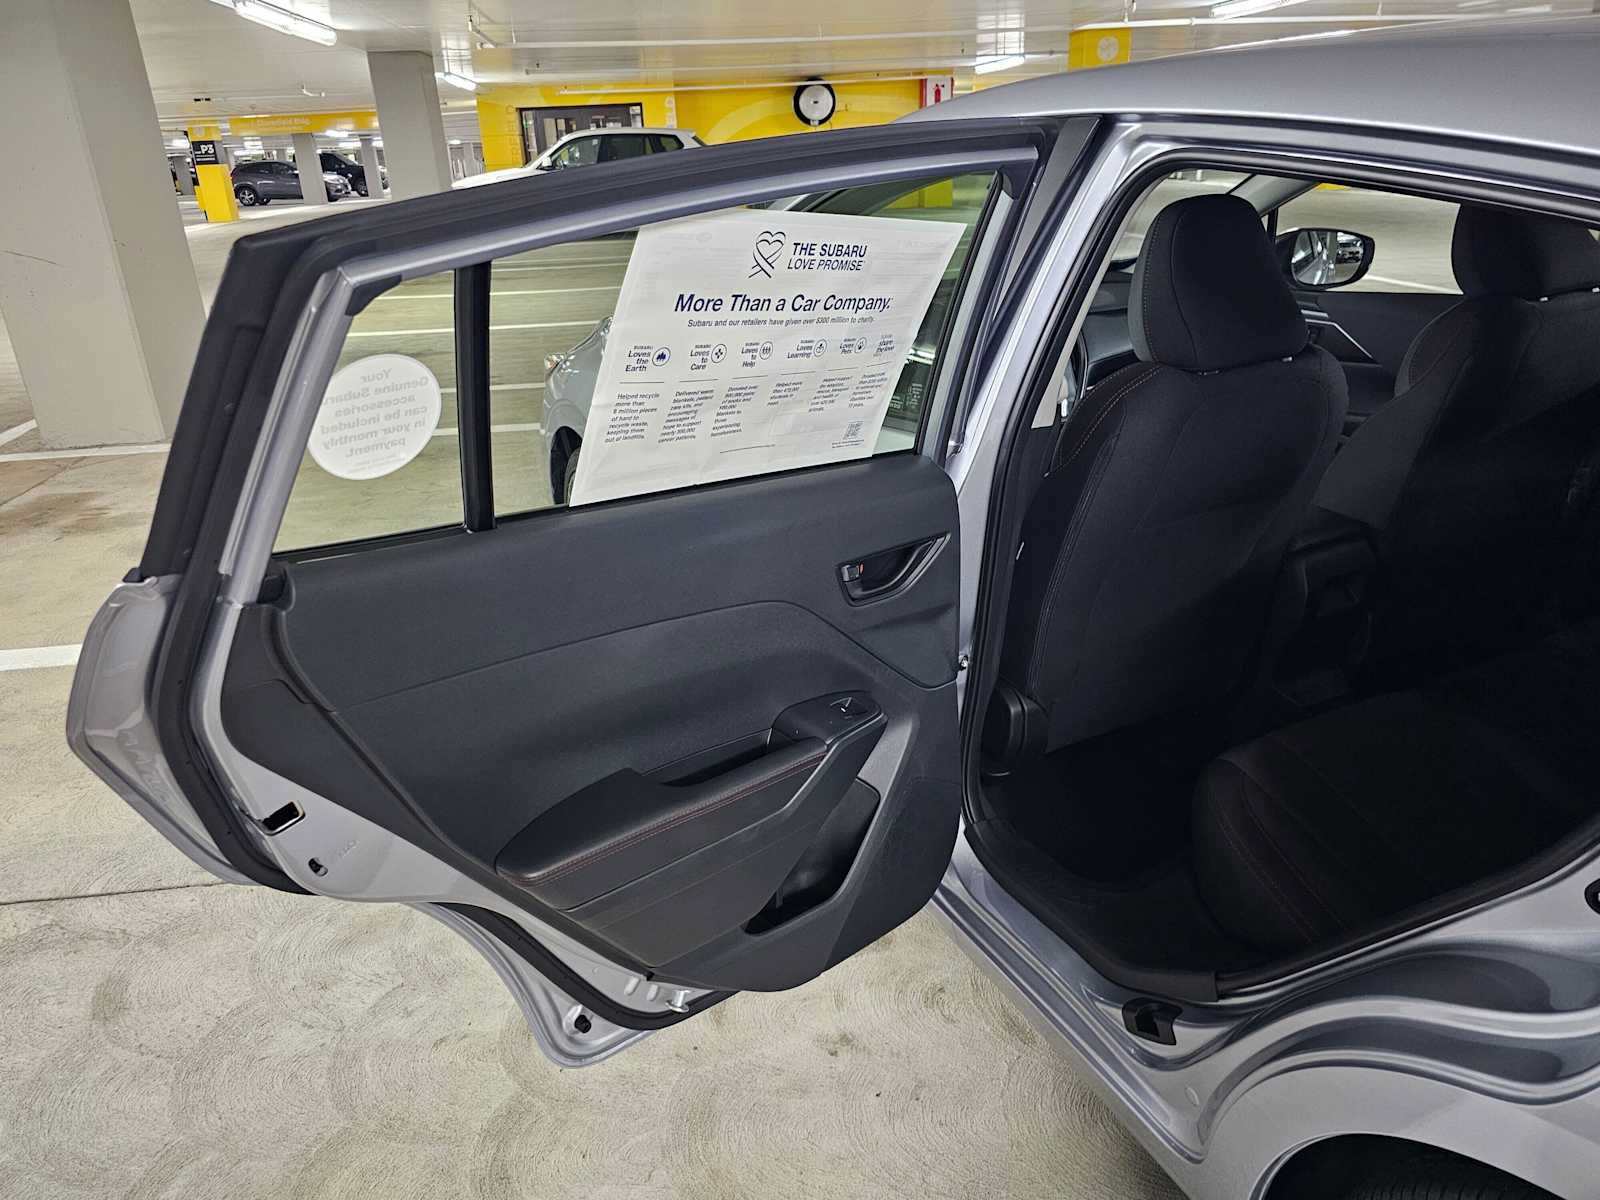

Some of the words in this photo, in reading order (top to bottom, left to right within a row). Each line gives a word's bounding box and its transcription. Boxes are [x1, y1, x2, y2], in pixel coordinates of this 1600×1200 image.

[200, 144, 214, 154] P3
[792, 242, 817, 256] THE
[819, 244, 868, 258] SUBARU
[787, 258, 816, 270] LOVE
[818, 259, 864, 271] PROMISE
[674, 294, 723, 312] More
[730, 294, 772, 312] Than
[775, 298, 785, 312] a
[791, 294, 821, 312] Car
[688, 319, 713, 327] Subaru
[714, 319, 728, 327] and
[784, 318, 801, 327] given
